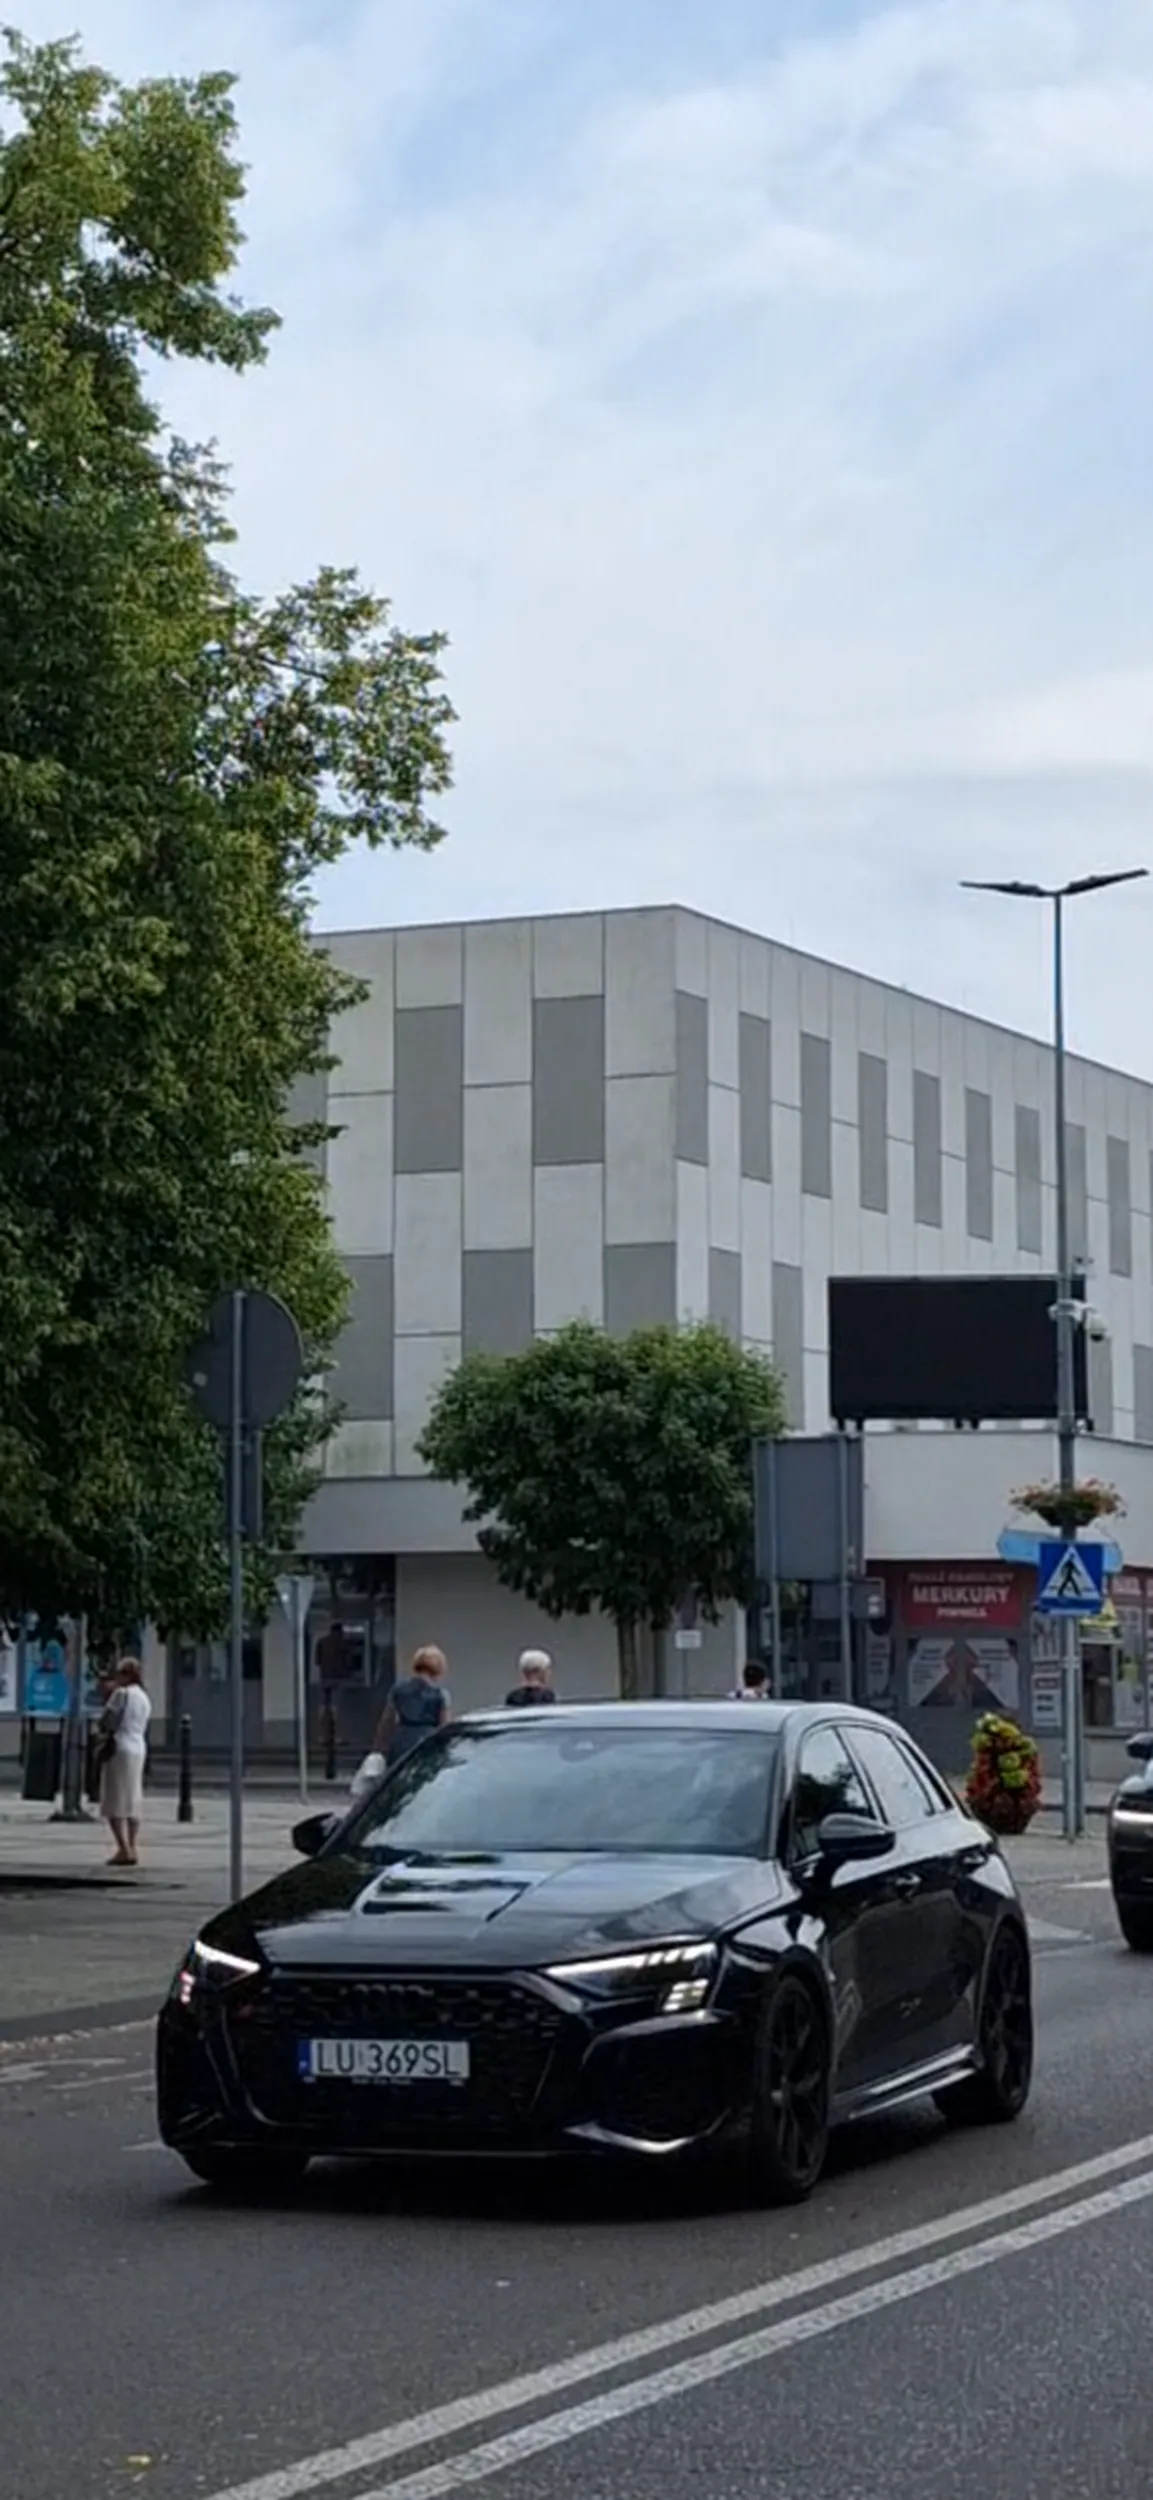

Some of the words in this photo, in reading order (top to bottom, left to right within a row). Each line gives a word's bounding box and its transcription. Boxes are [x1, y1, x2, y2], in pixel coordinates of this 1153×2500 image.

[912, 1586, 1010, 1603] MERKURY
[317, 2042, 355, 2073] LU
[367, 2043, 460, 2075] 369SL
